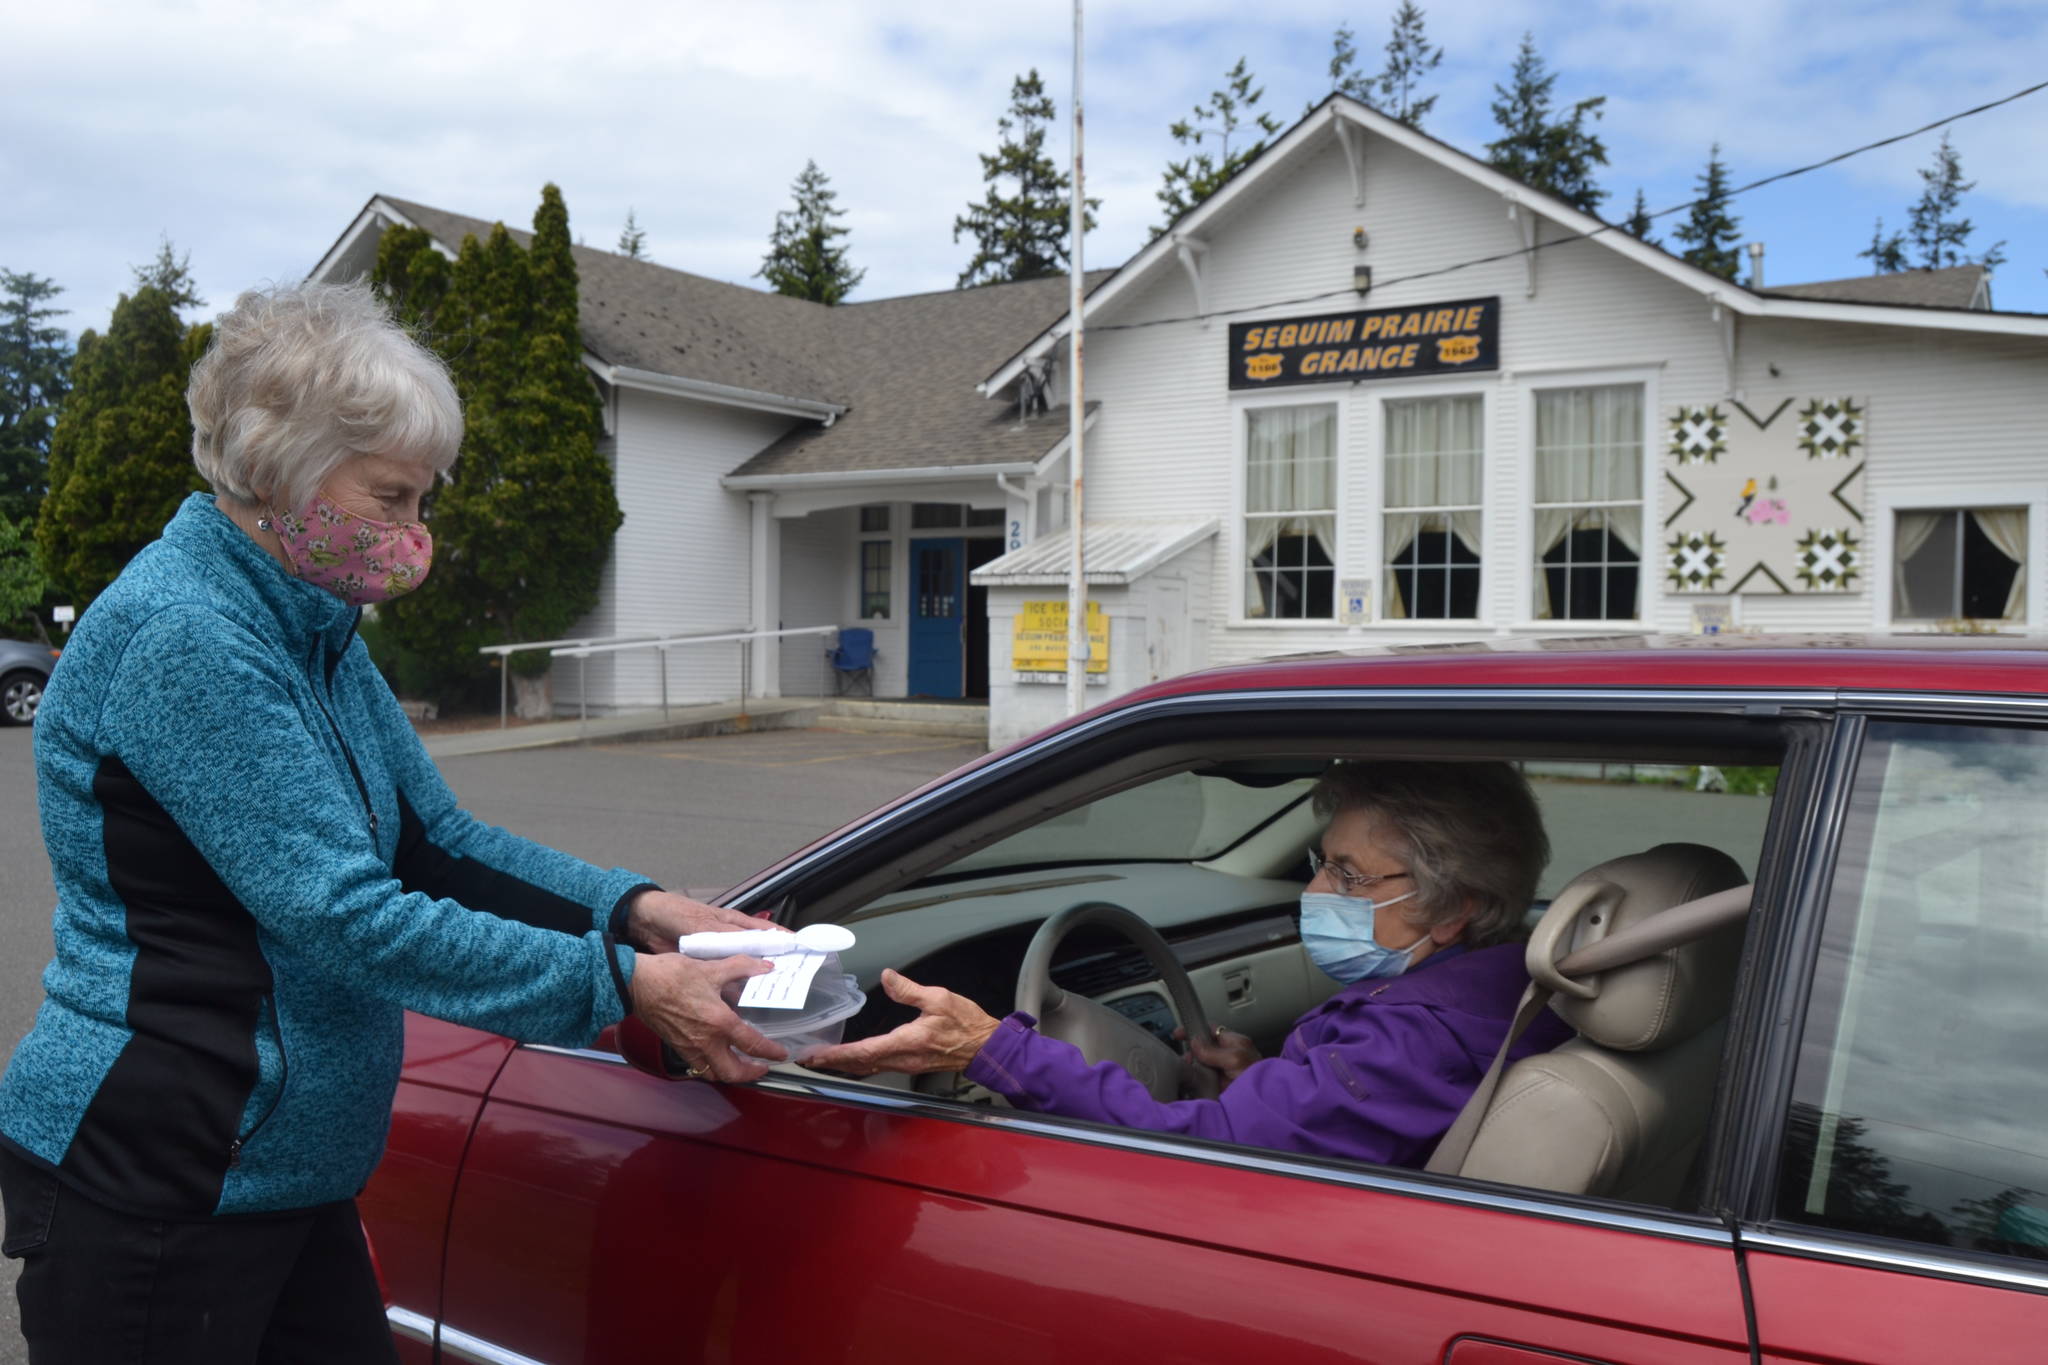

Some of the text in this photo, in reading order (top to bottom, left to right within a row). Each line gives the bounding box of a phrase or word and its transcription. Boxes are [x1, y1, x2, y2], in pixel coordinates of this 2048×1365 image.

[1243, 307, 1483, 350] SEQUIM PRAIRIE
[1300, 344, 1420, 375] GRANGE
[1029, 603, 1047, 615] ICE
[1039, 616, 1069, 628] SOCIA
